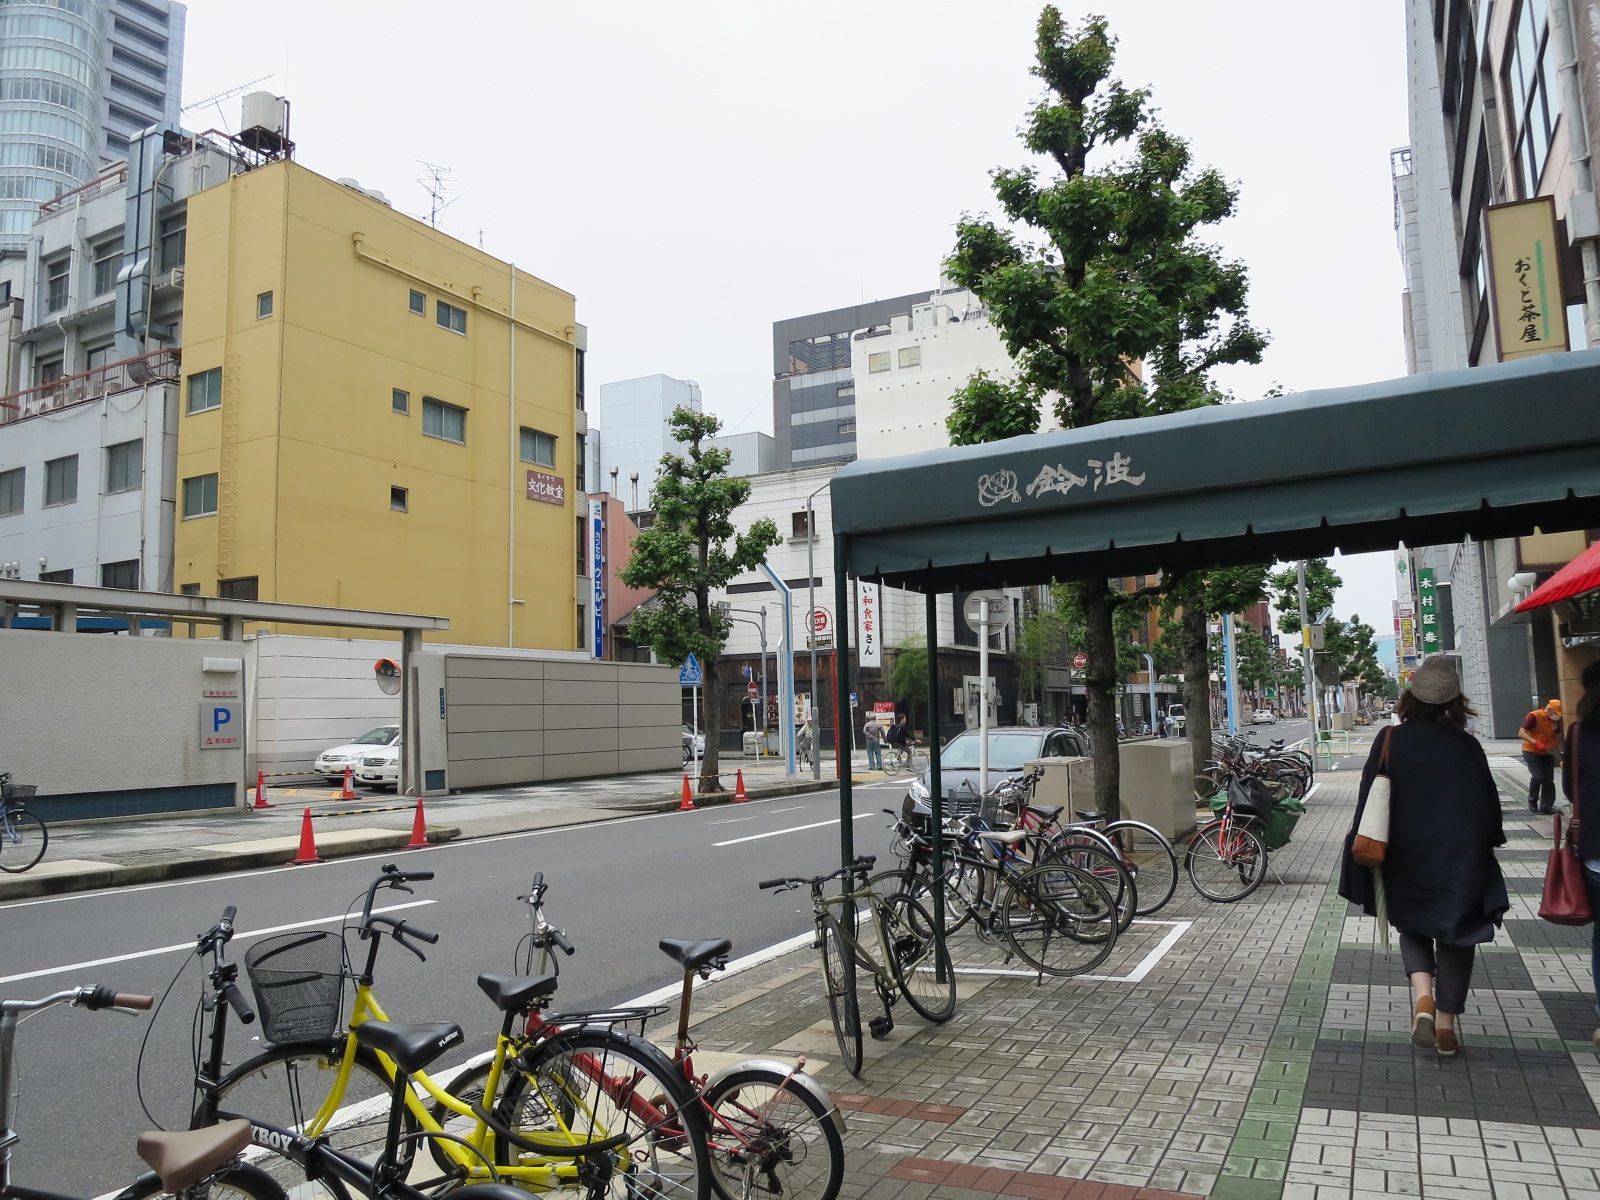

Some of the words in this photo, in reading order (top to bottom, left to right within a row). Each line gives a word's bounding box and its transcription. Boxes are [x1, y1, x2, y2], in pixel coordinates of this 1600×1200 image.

[527, 478, 564, 500] 文化教室
[1025, 451, 1147, 499] 鈴波
[1419, 577, 1438, 644] 木村証券
[213, 707, 231, 732] P
